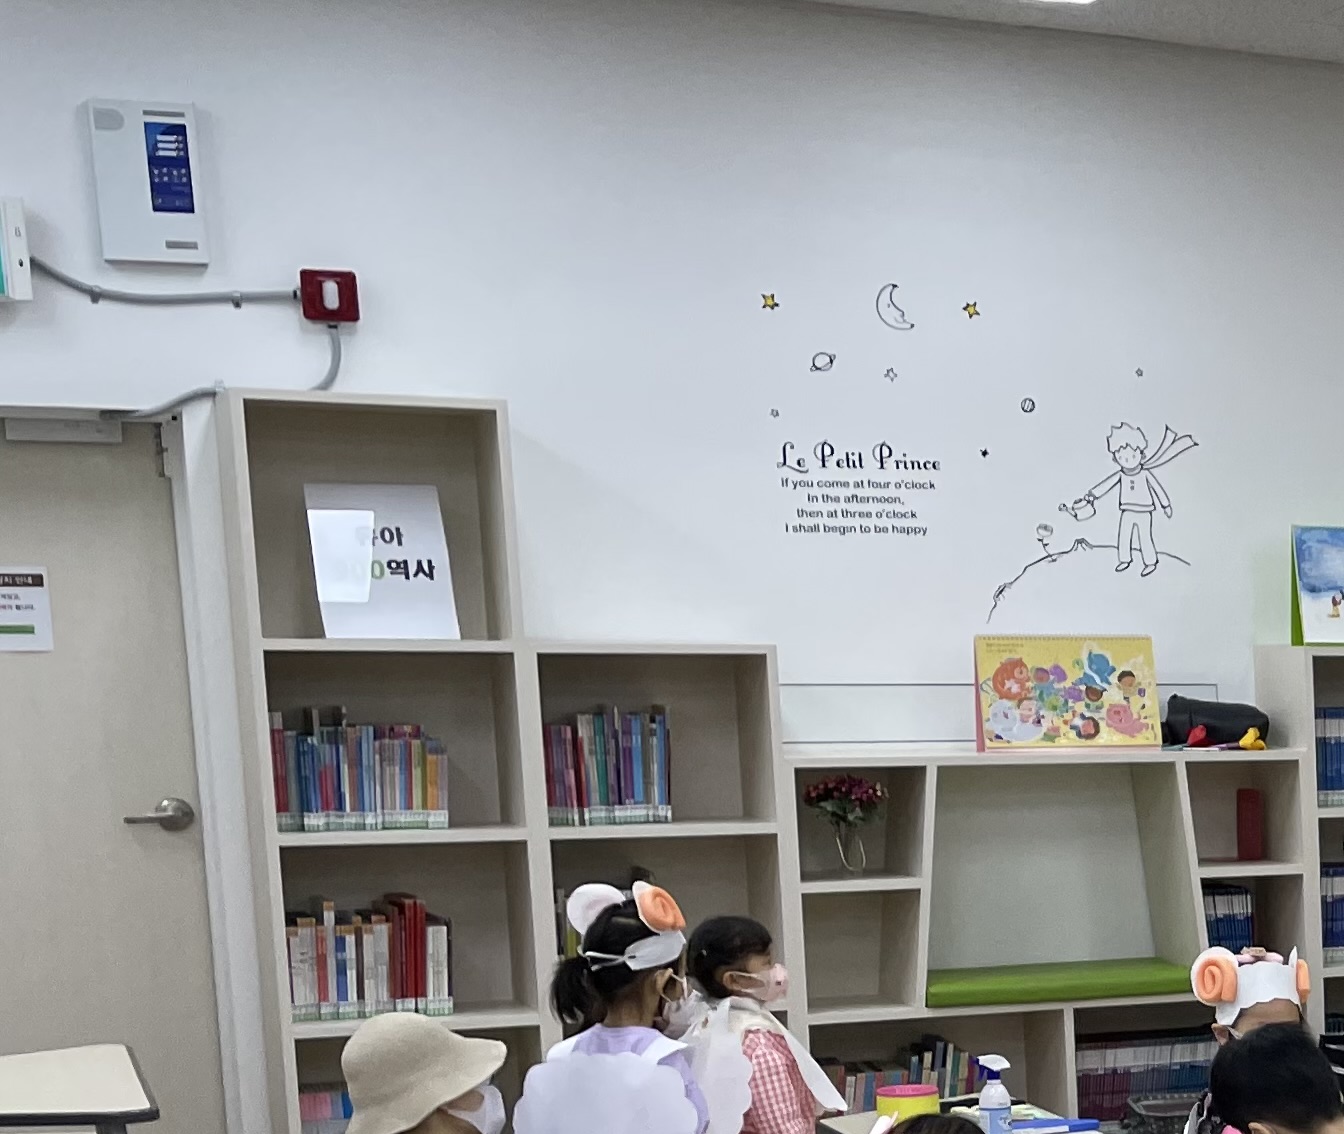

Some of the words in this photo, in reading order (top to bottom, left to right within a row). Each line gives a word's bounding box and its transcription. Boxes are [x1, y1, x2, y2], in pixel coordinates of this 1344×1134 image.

[777, 441, 809, 473] Le
[813, 439, 864, 469] Petit
[872, 440, 941, 470] Prince
[792, 480, 814, 490] you
[816, 480, 850, 489] come
[853, 479, 864, 489] at
[868, 479, 891, 489] four
[821, 493, 840, 503] the
[843, 493, 905, 505] afternoon,
[796, 508, 824, 518] then
[826, 508, 838, 518] at
[841, 508, 872, 518] three
[792, 523, 820, 533] shall
[823, 523, 856, 536] begin
[860, 524, 871, 533] to
[874, 523, 889, 533] be
[892, 524, 928, 536] happy
